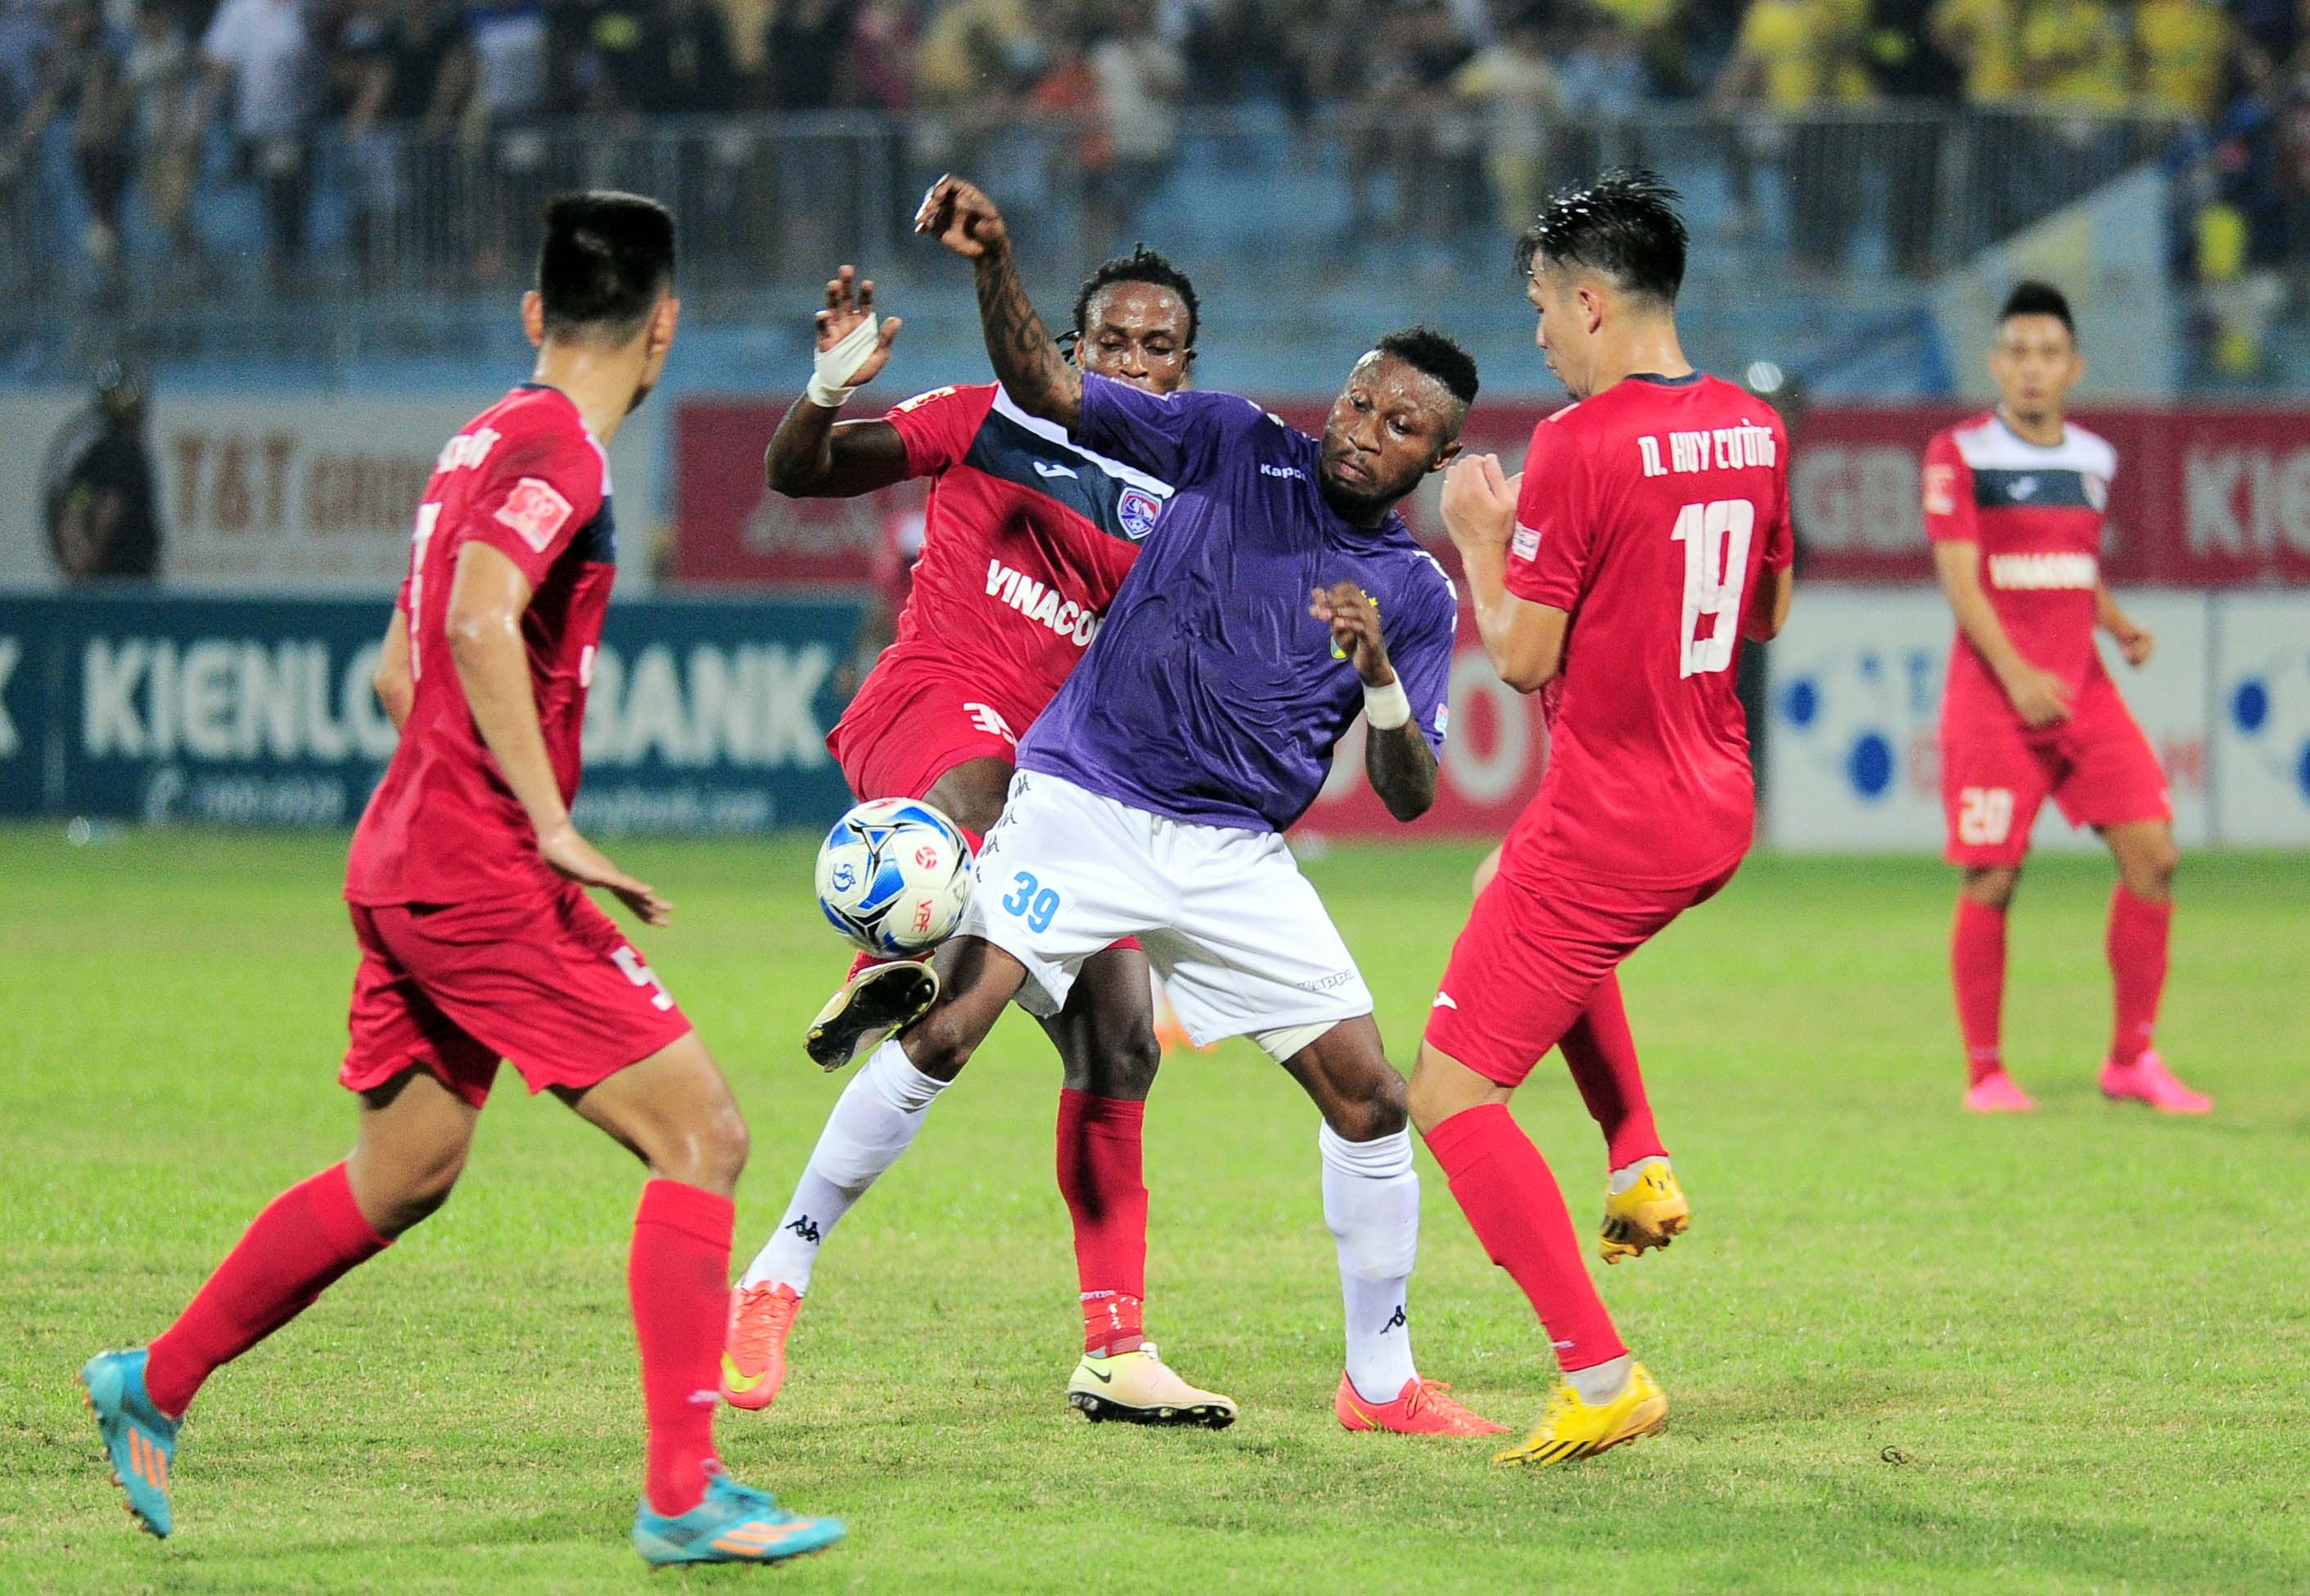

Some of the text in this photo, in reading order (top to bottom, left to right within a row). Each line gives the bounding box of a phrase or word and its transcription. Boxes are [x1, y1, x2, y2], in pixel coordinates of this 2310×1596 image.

[1670, 498, 1755, 680] 19
[1958, 787, 2014, 845] 20
[1003, 871, 1060, 934] 39
